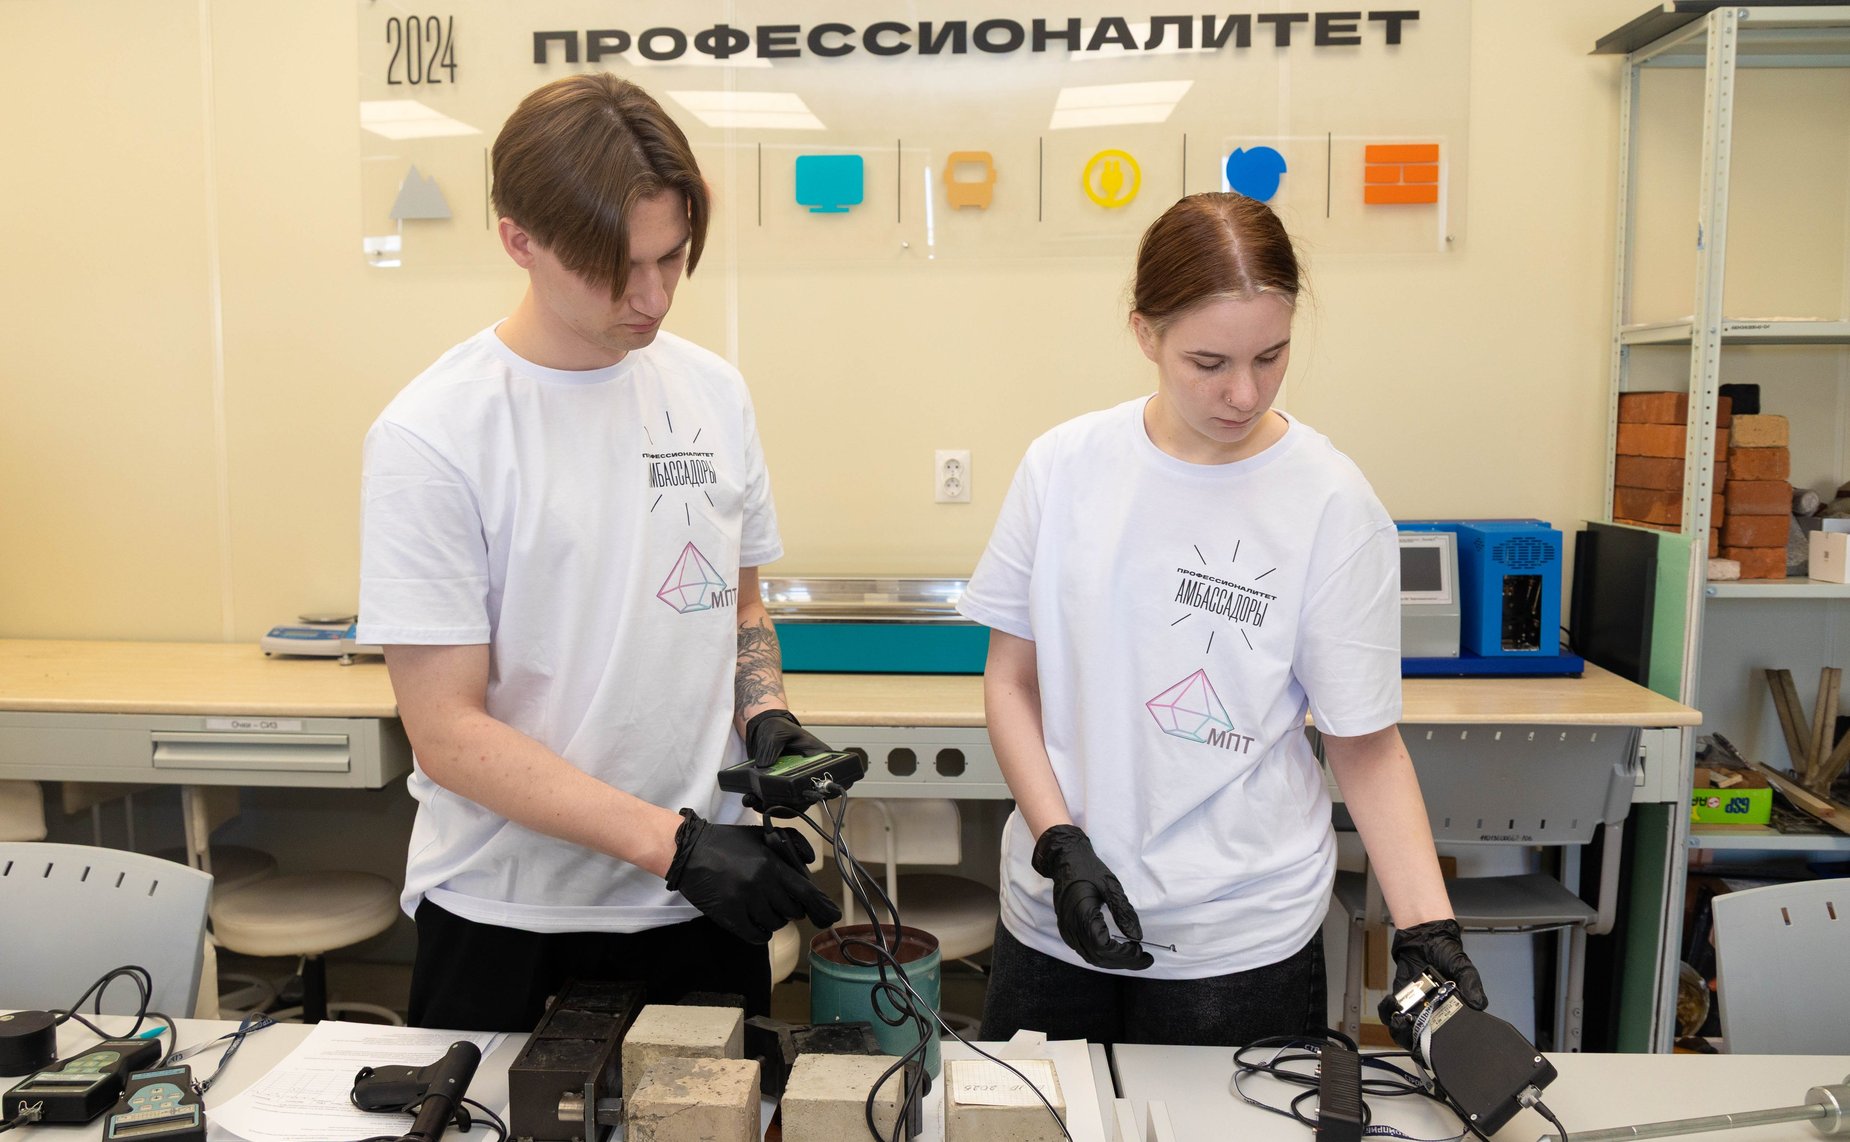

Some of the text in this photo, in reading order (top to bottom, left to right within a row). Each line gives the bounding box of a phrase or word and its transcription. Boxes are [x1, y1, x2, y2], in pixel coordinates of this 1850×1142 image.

[386, 15, 457, 86] 2024
[533, 10, 1420, 65] ПРОФЕССИОНАЛИТЕТ
[642, 451, 714, 459] ПФЕССИОНАЛИТЕТ
[649, 459, 717, 488] МБАССАДОРЫ
[711, 588, 737, 609] МПТ
[1177, 568, 1277, 601] ПРОФЕССИОНАЛИТЕТ
[1174, 578, 1269, 627] АМБАССАДОРЫ
[1206, 727, 1255, 754] МПТ
